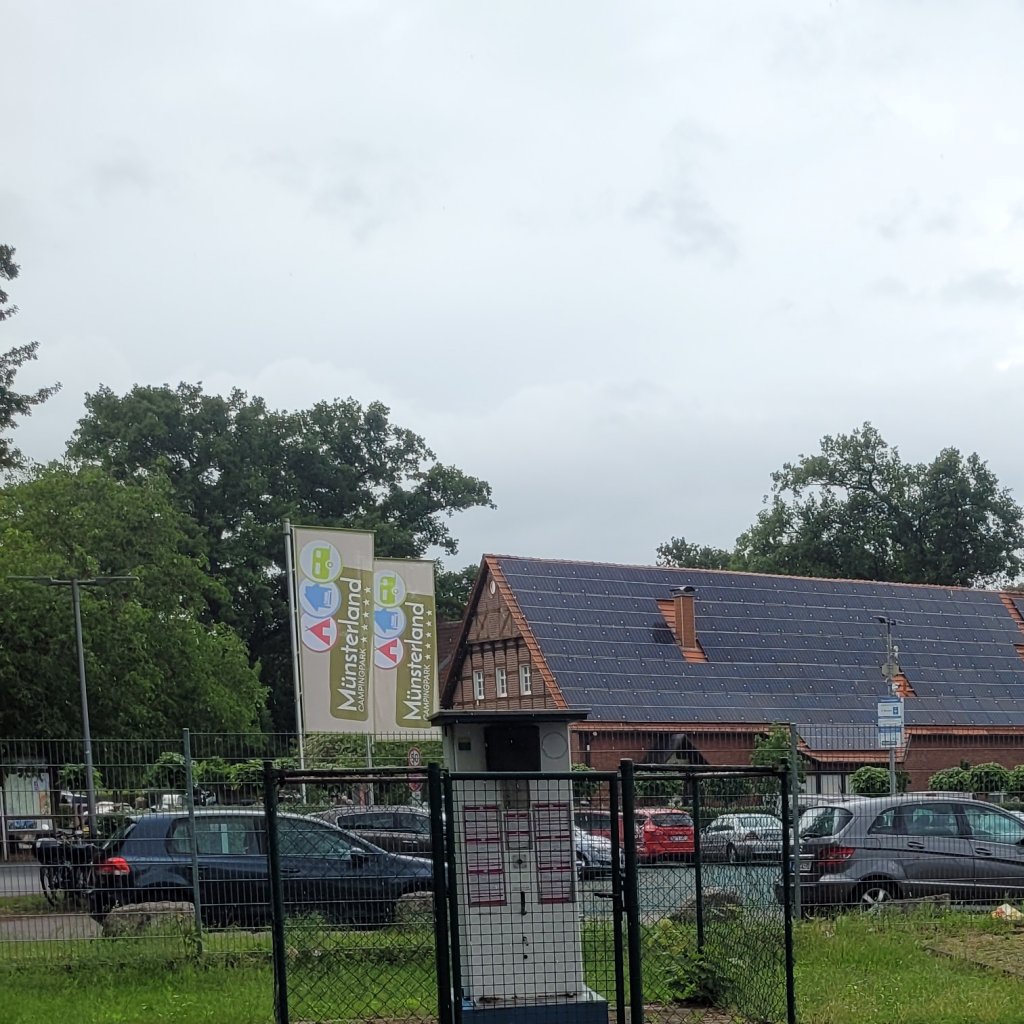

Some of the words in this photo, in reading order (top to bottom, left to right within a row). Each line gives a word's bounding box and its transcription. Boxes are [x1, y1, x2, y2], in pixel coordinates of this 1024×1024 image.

[337, 577, 362, 711] Münsterland
[358, 648, 366, 712] CAMPINGPARK
[402, 602, 425, 720] Münsterland
[423, 664, 431, 720] CAMPINGPARK
